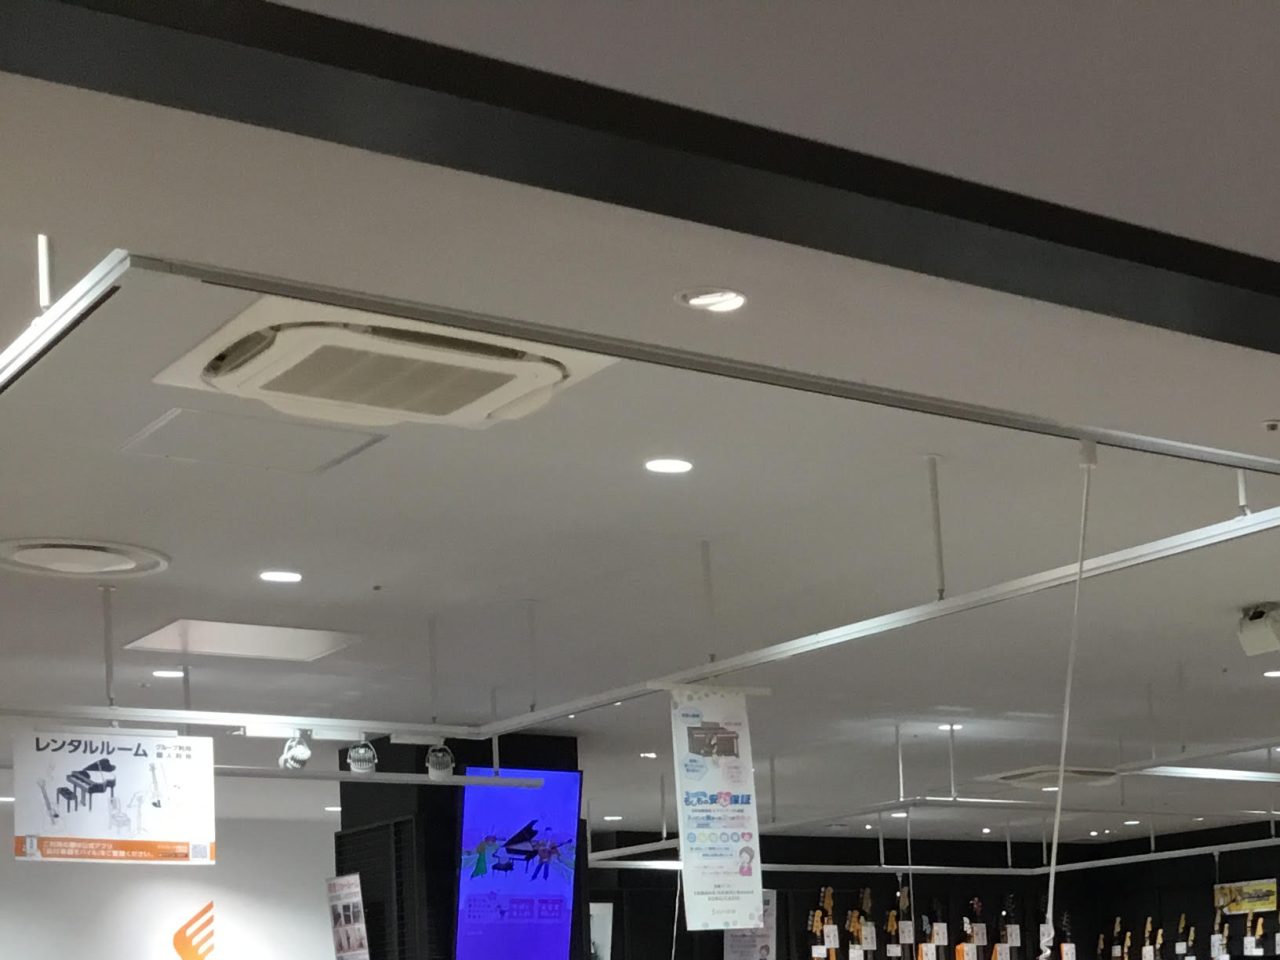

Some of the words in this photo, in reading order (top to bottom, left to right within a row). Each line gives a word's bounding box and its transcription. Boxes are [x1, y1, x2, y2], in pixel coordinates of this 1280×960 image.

[35, 737, 149, 758] レンタルルーム
